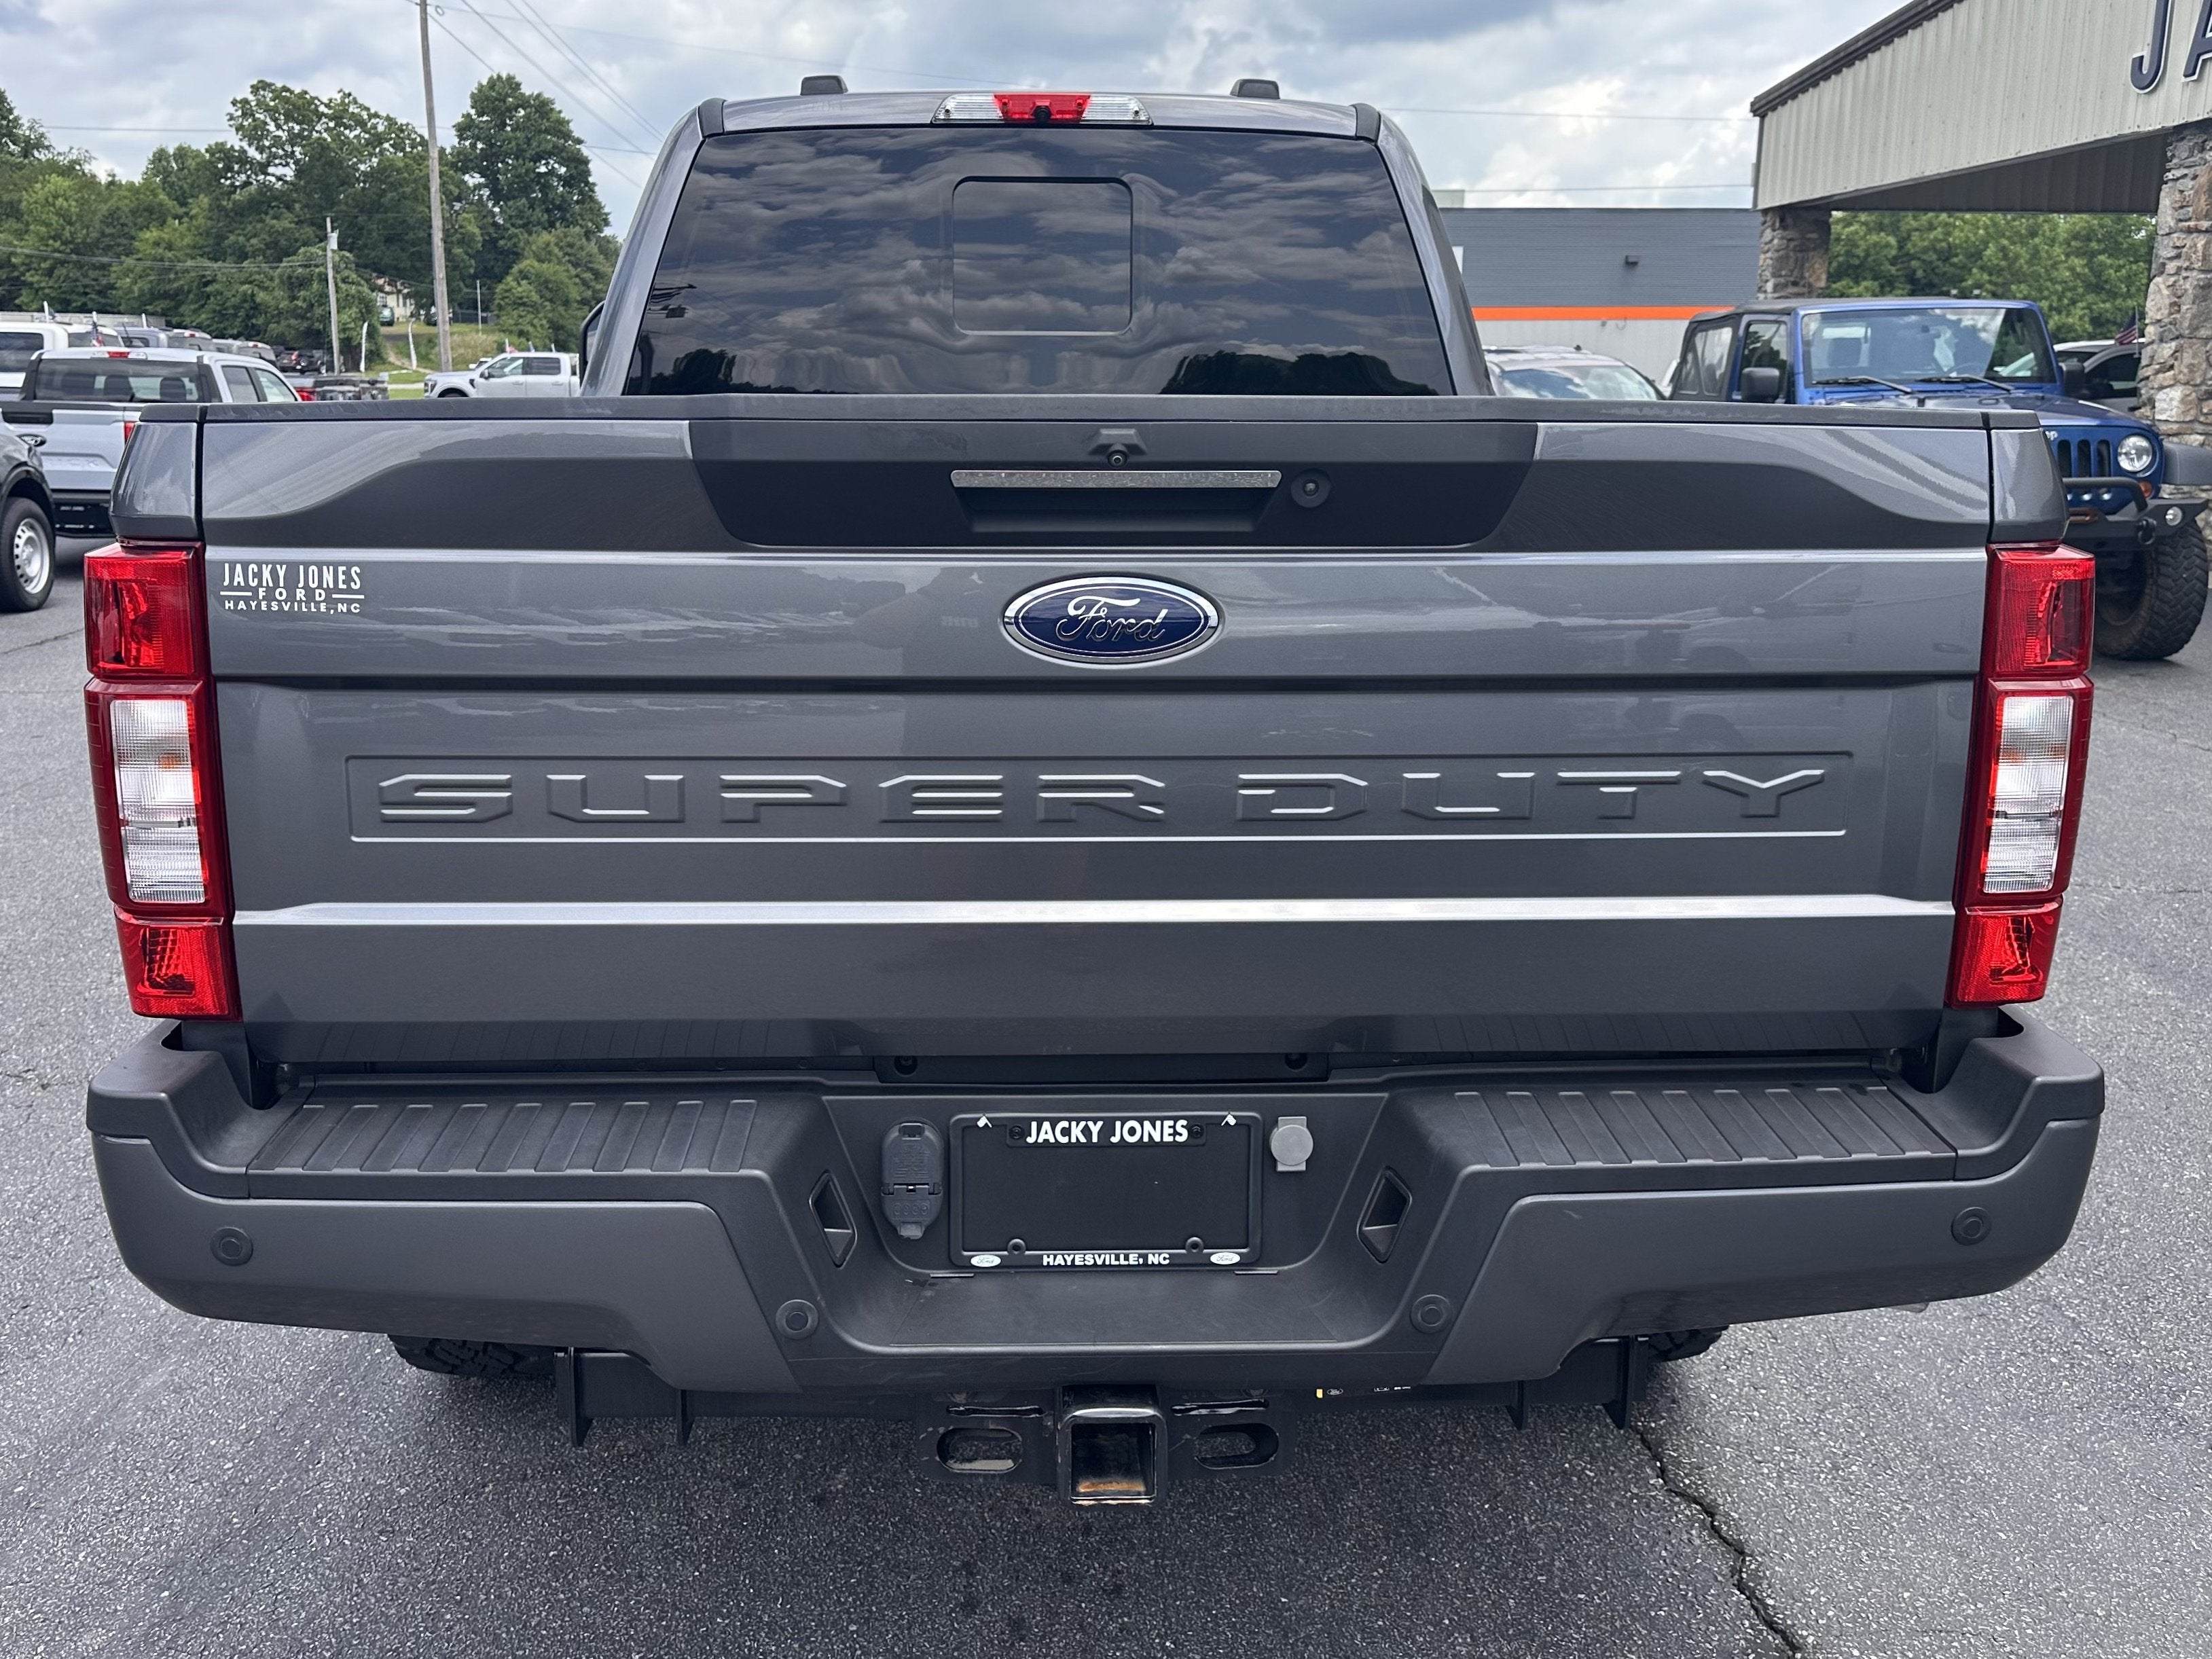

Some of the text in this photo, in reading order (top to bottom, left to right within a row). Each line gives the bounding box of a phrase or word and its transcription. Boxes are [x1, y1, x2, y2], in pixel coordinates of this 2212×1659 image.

[223, 563, 361, 589] JACKY JONES
[258, 587, 326, 602] FORD
[1055, 596, 1169, 642] Ford
[378, 770, 1826, 823] SUPER DUTY
[1026, 1119, 1189, 1144] JACKY JONES
[1042, 1253, 1170, 1266] HAYESVILLE, NC
